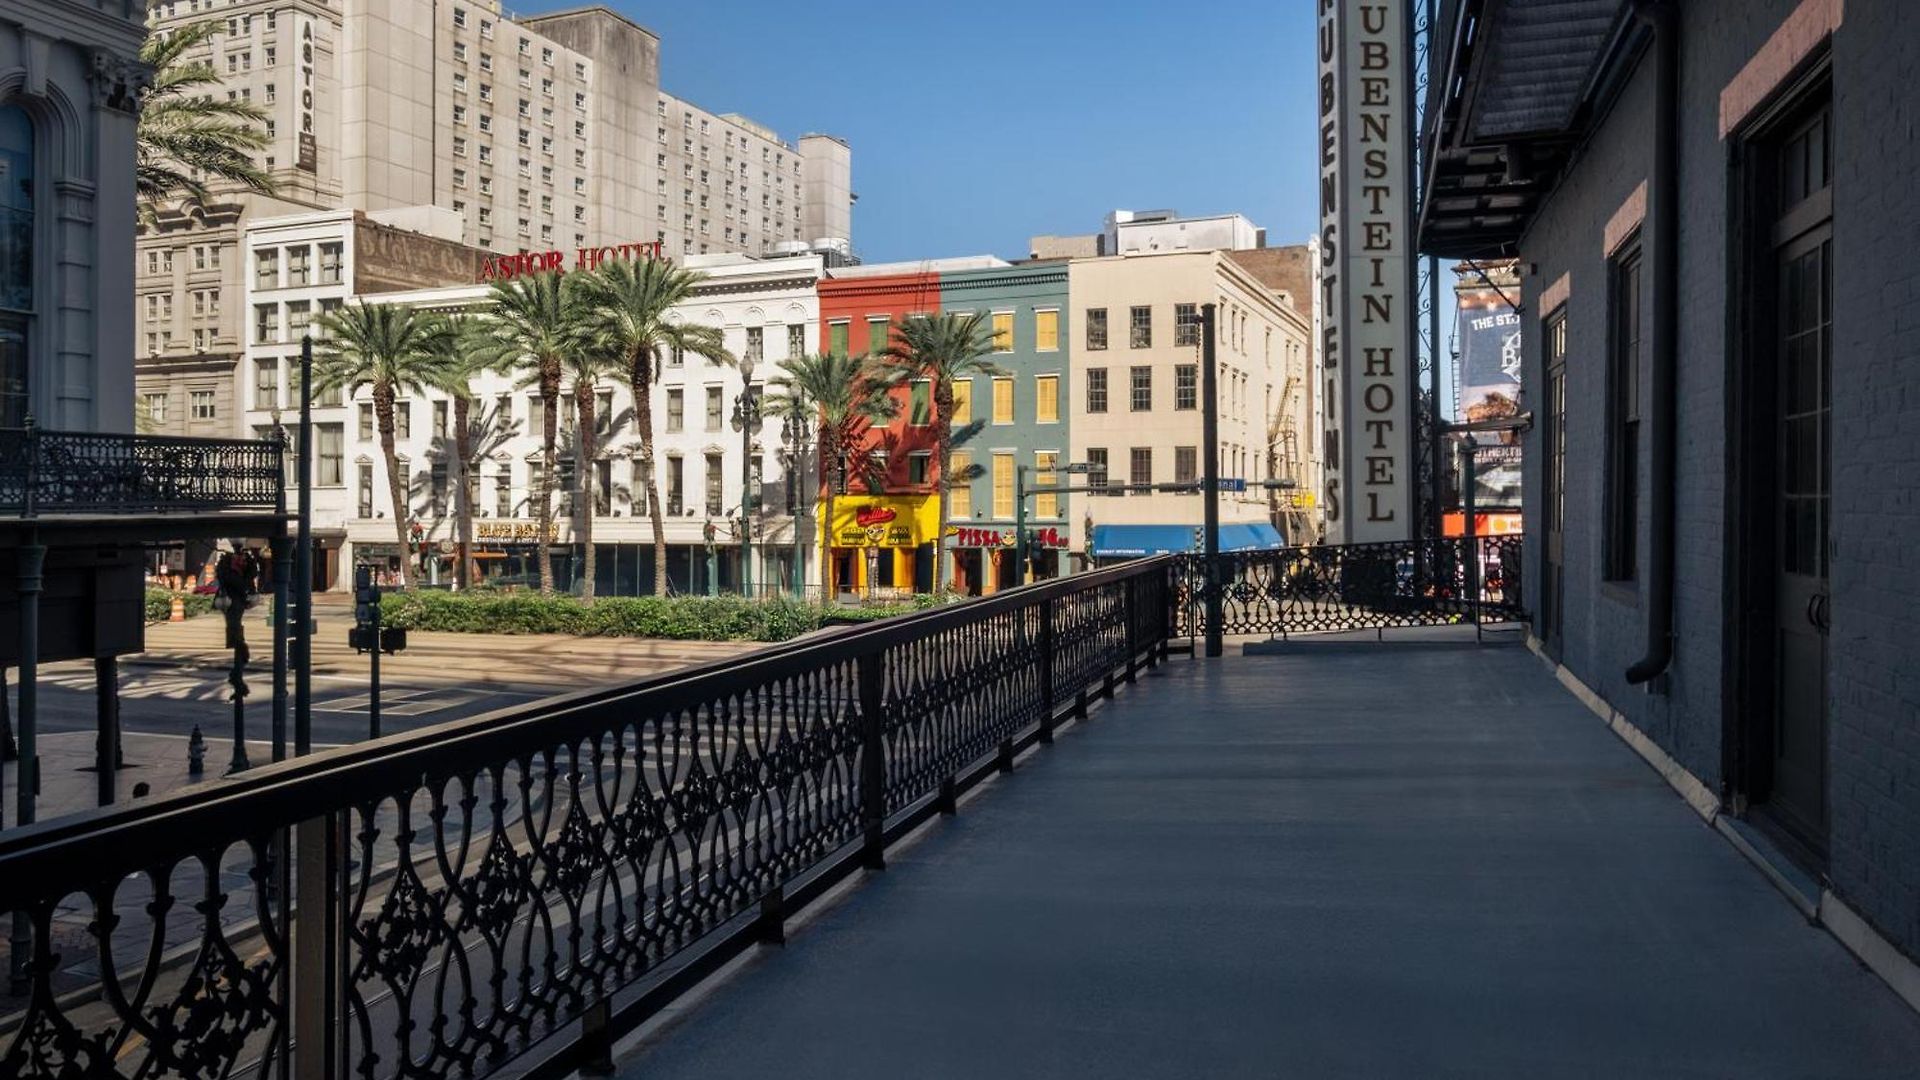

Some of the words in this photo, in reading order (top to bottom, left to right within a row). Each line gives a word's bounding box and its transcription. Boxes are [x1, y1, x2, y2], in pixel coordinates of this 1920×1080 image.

[302, 21, 313, 133] ASTOR
[479, 250, 566, 281] ASTOR
[575, 241, 672, 272] HOTEL
[1471, 316, 1494, 331] THE
[1363, 348, 1394, 522] HOTEL
